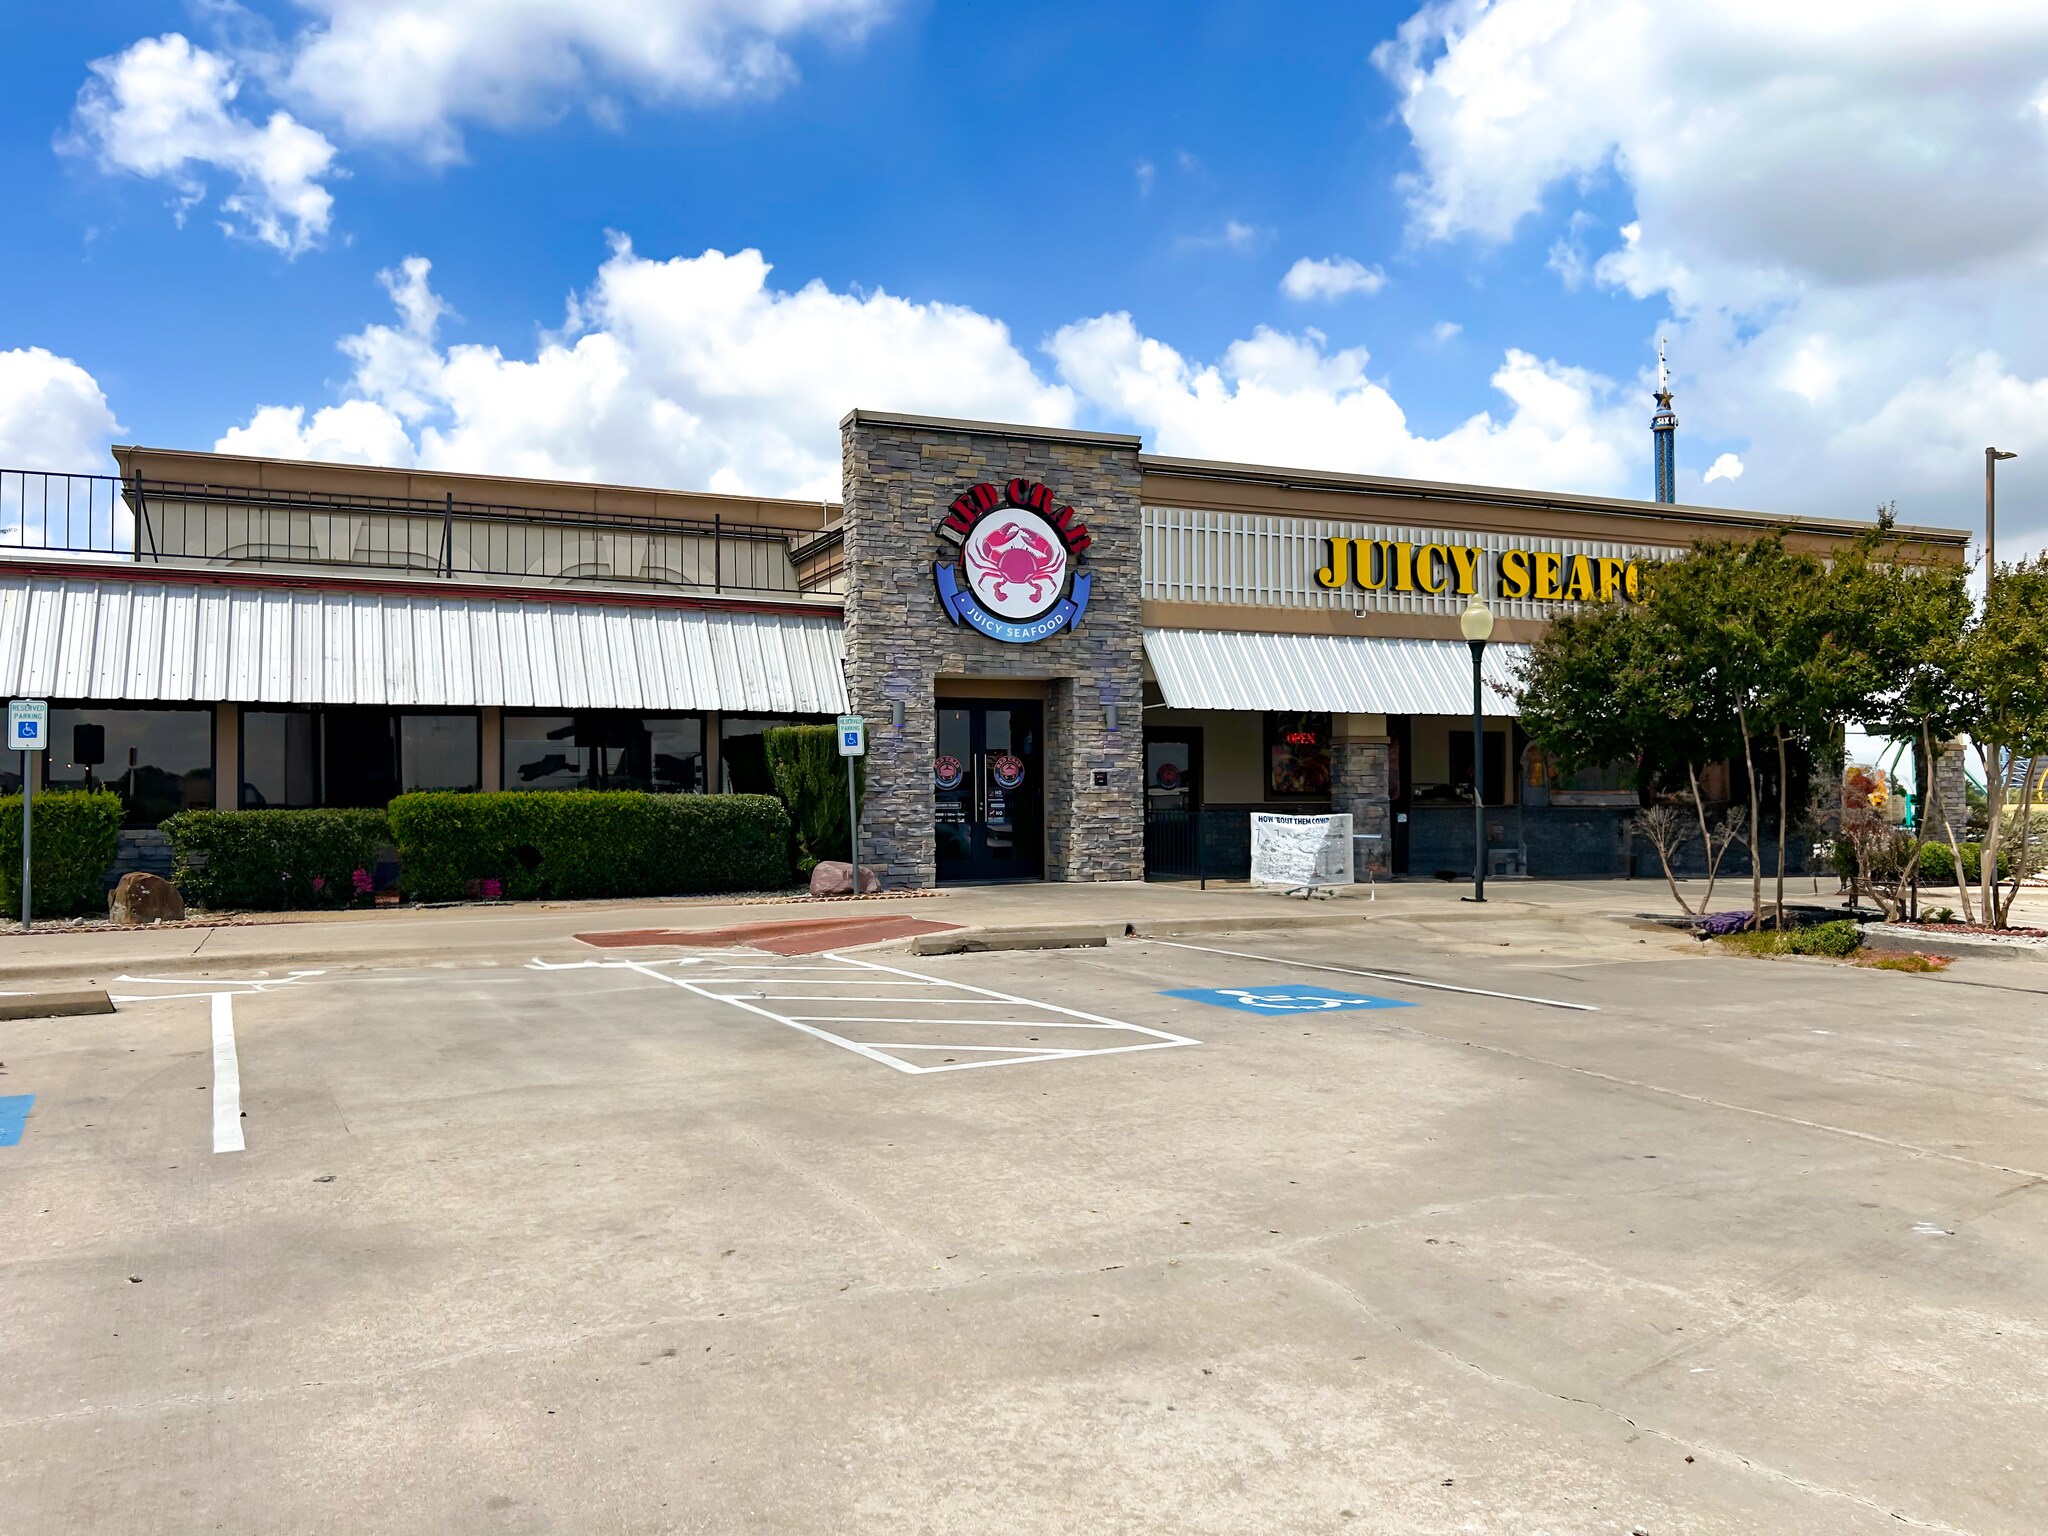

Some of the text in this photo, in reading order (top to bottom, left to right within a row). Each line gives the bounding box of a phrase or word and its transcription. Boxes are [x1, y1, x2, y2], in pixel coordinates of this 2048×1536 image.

[1657, 417, 1669, 425] SIX
[935, 477, 1092, 553] RED CRAB
[1314, 537, 1483, 595] JUICY
[967, 608, 1064, 638] JUICY SEAFOOD
[1287, 732, 1315, 744] OPEN
[1258, 815, 1273, 823] HOW
[1293, 817, 1311, 825] THEM
